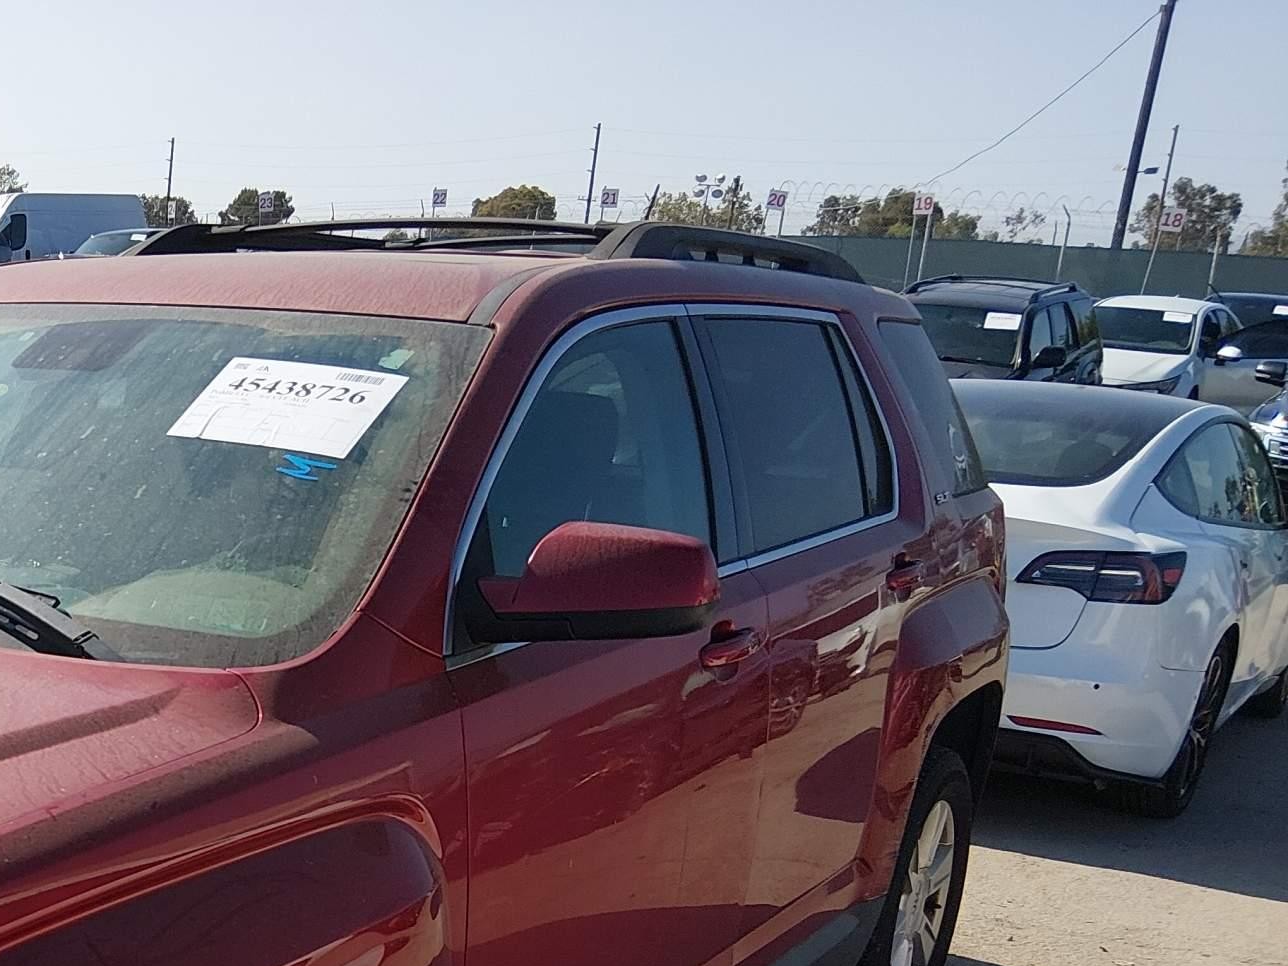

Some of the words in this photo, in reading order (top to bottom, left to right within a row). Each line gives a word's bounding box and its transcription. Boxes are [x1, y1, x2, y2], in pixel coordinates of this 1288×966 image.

[259, 197, 273, 209] 23
[432, 192, 447, 205] 22
[602, 192, 617, 205] 21
[766, 193, 786, 207] 20
[914, 196, 933, 211] 19
[1161, 212, 1183, 228] 18
[228, 376, 372, 405] 45438726
